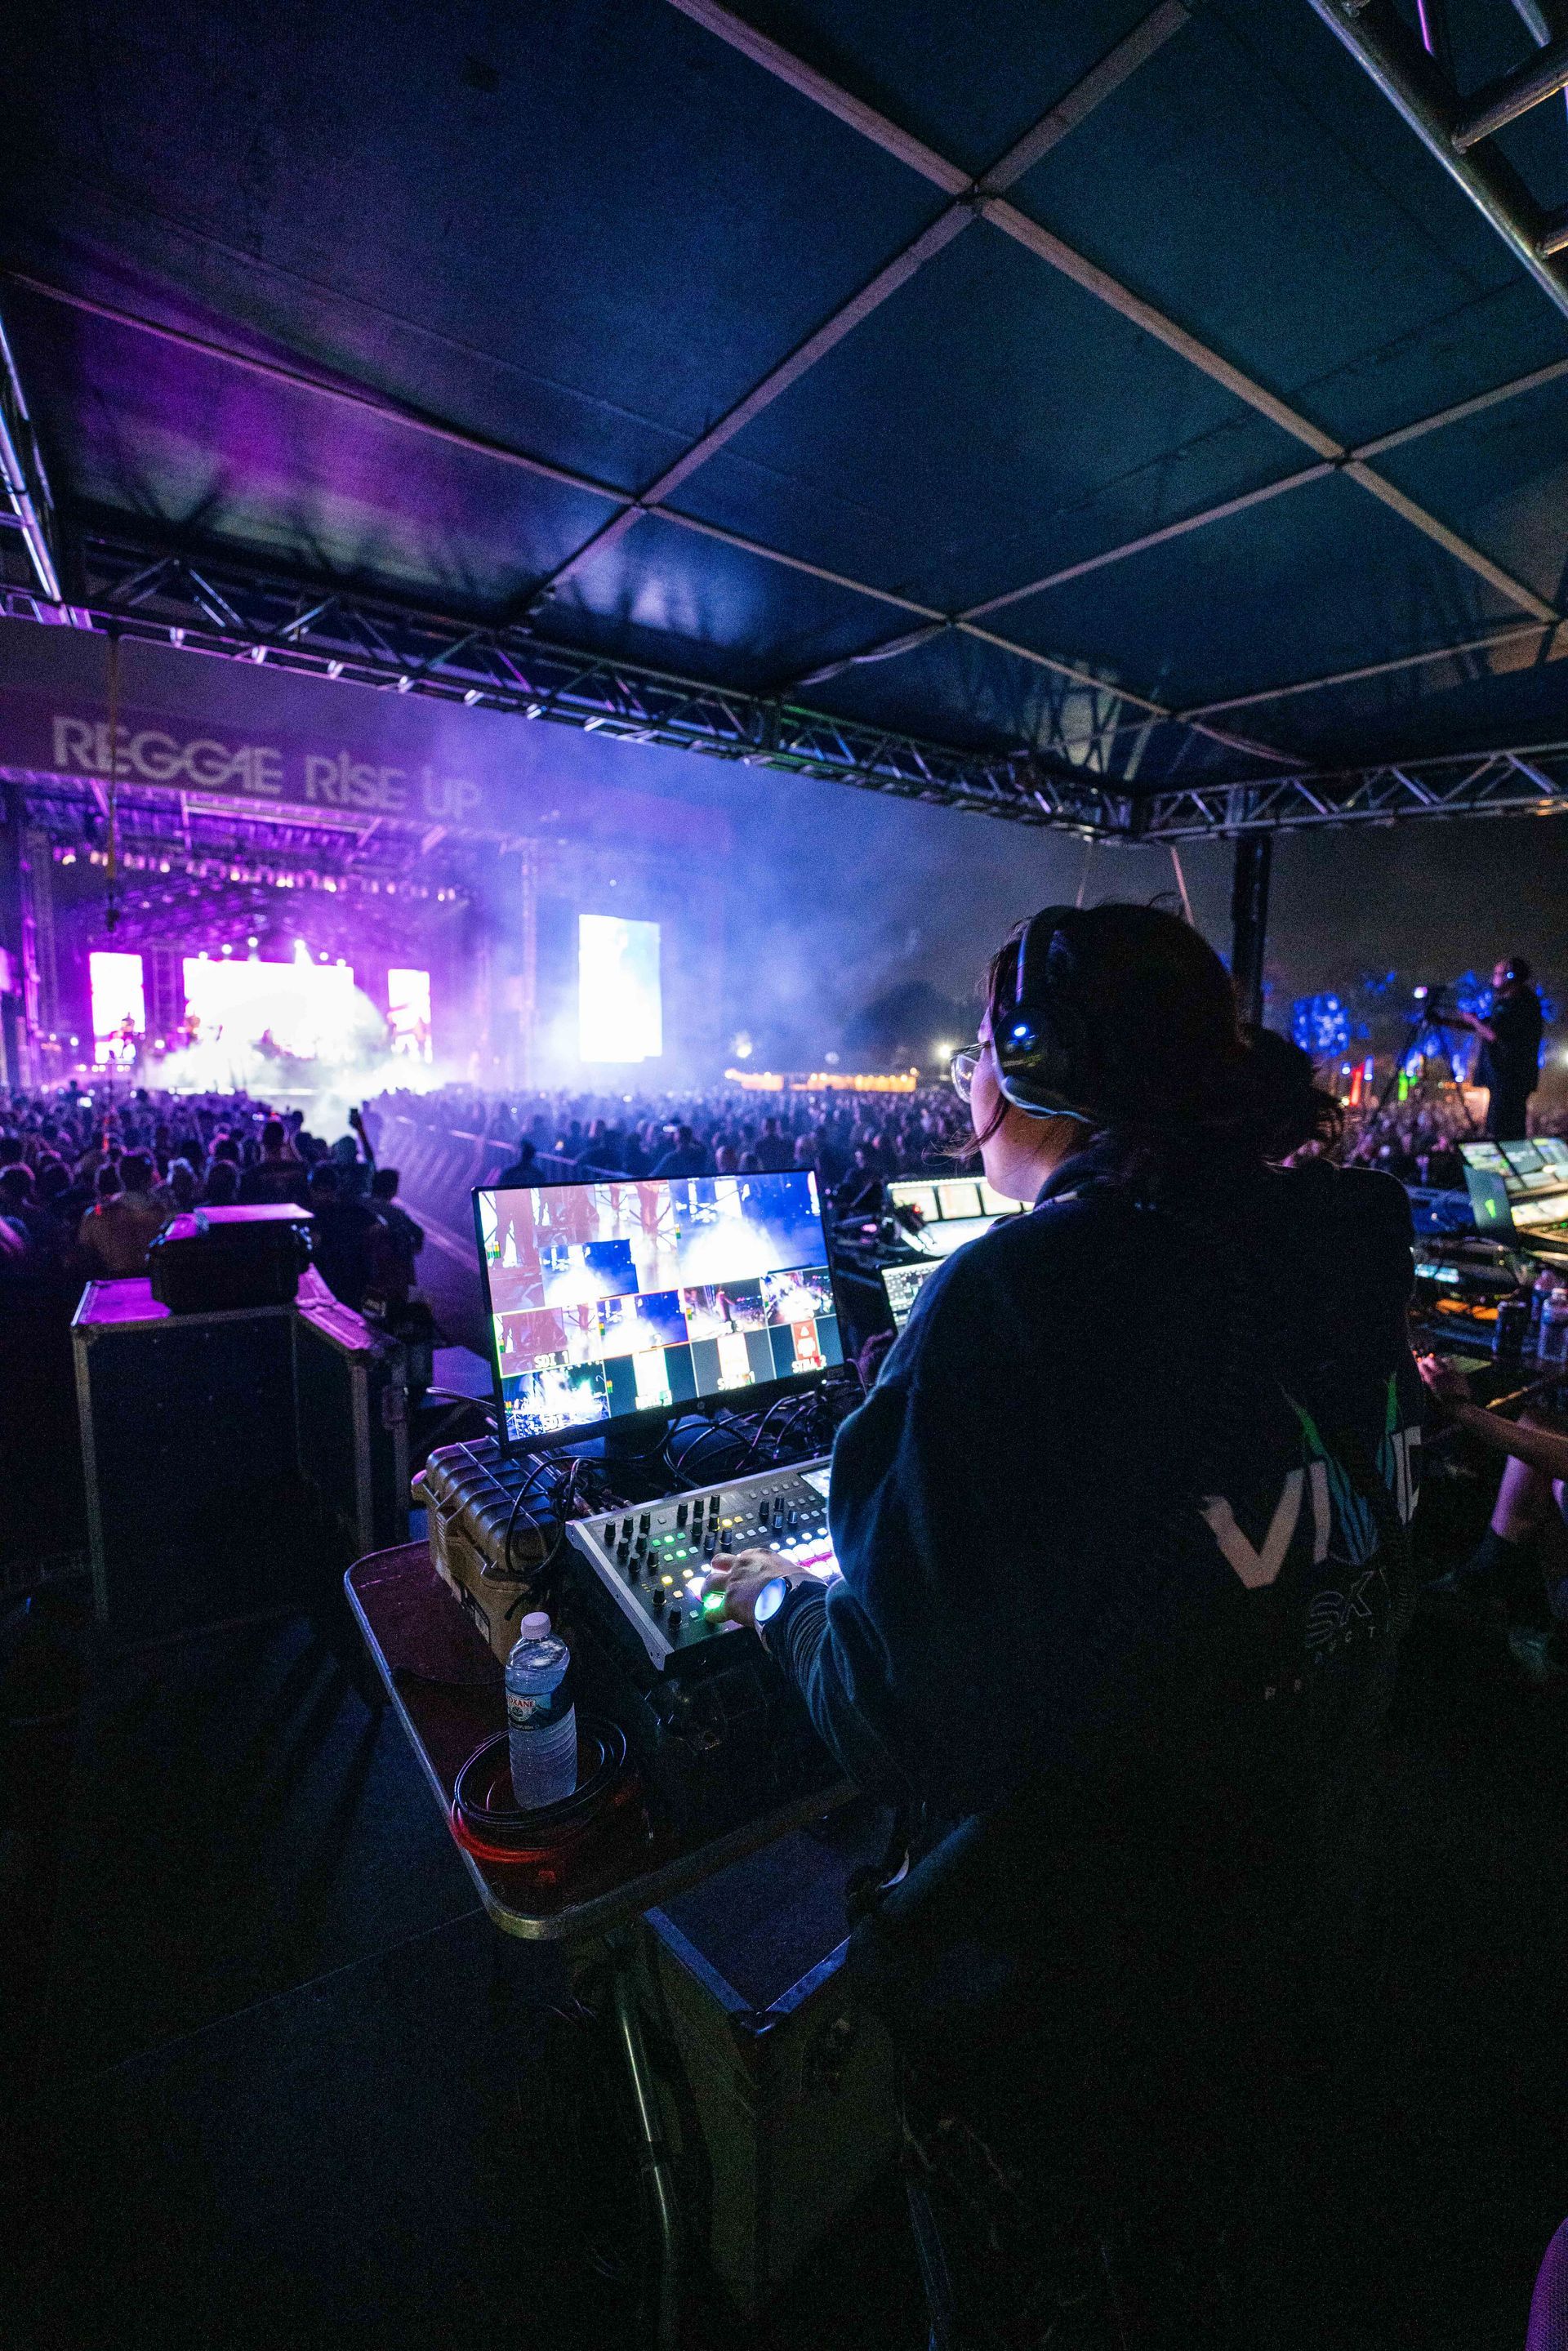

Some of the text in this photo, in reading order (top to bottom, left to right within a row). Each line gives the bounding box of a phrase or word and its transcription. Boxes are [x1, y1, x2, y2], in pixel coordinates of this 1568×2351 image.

[52, 715, 483, 820] REGGAE RISE UP
[534, 1350, 569, 1369] SDI 1
[506, 1694, 535, 1708] OXANE
